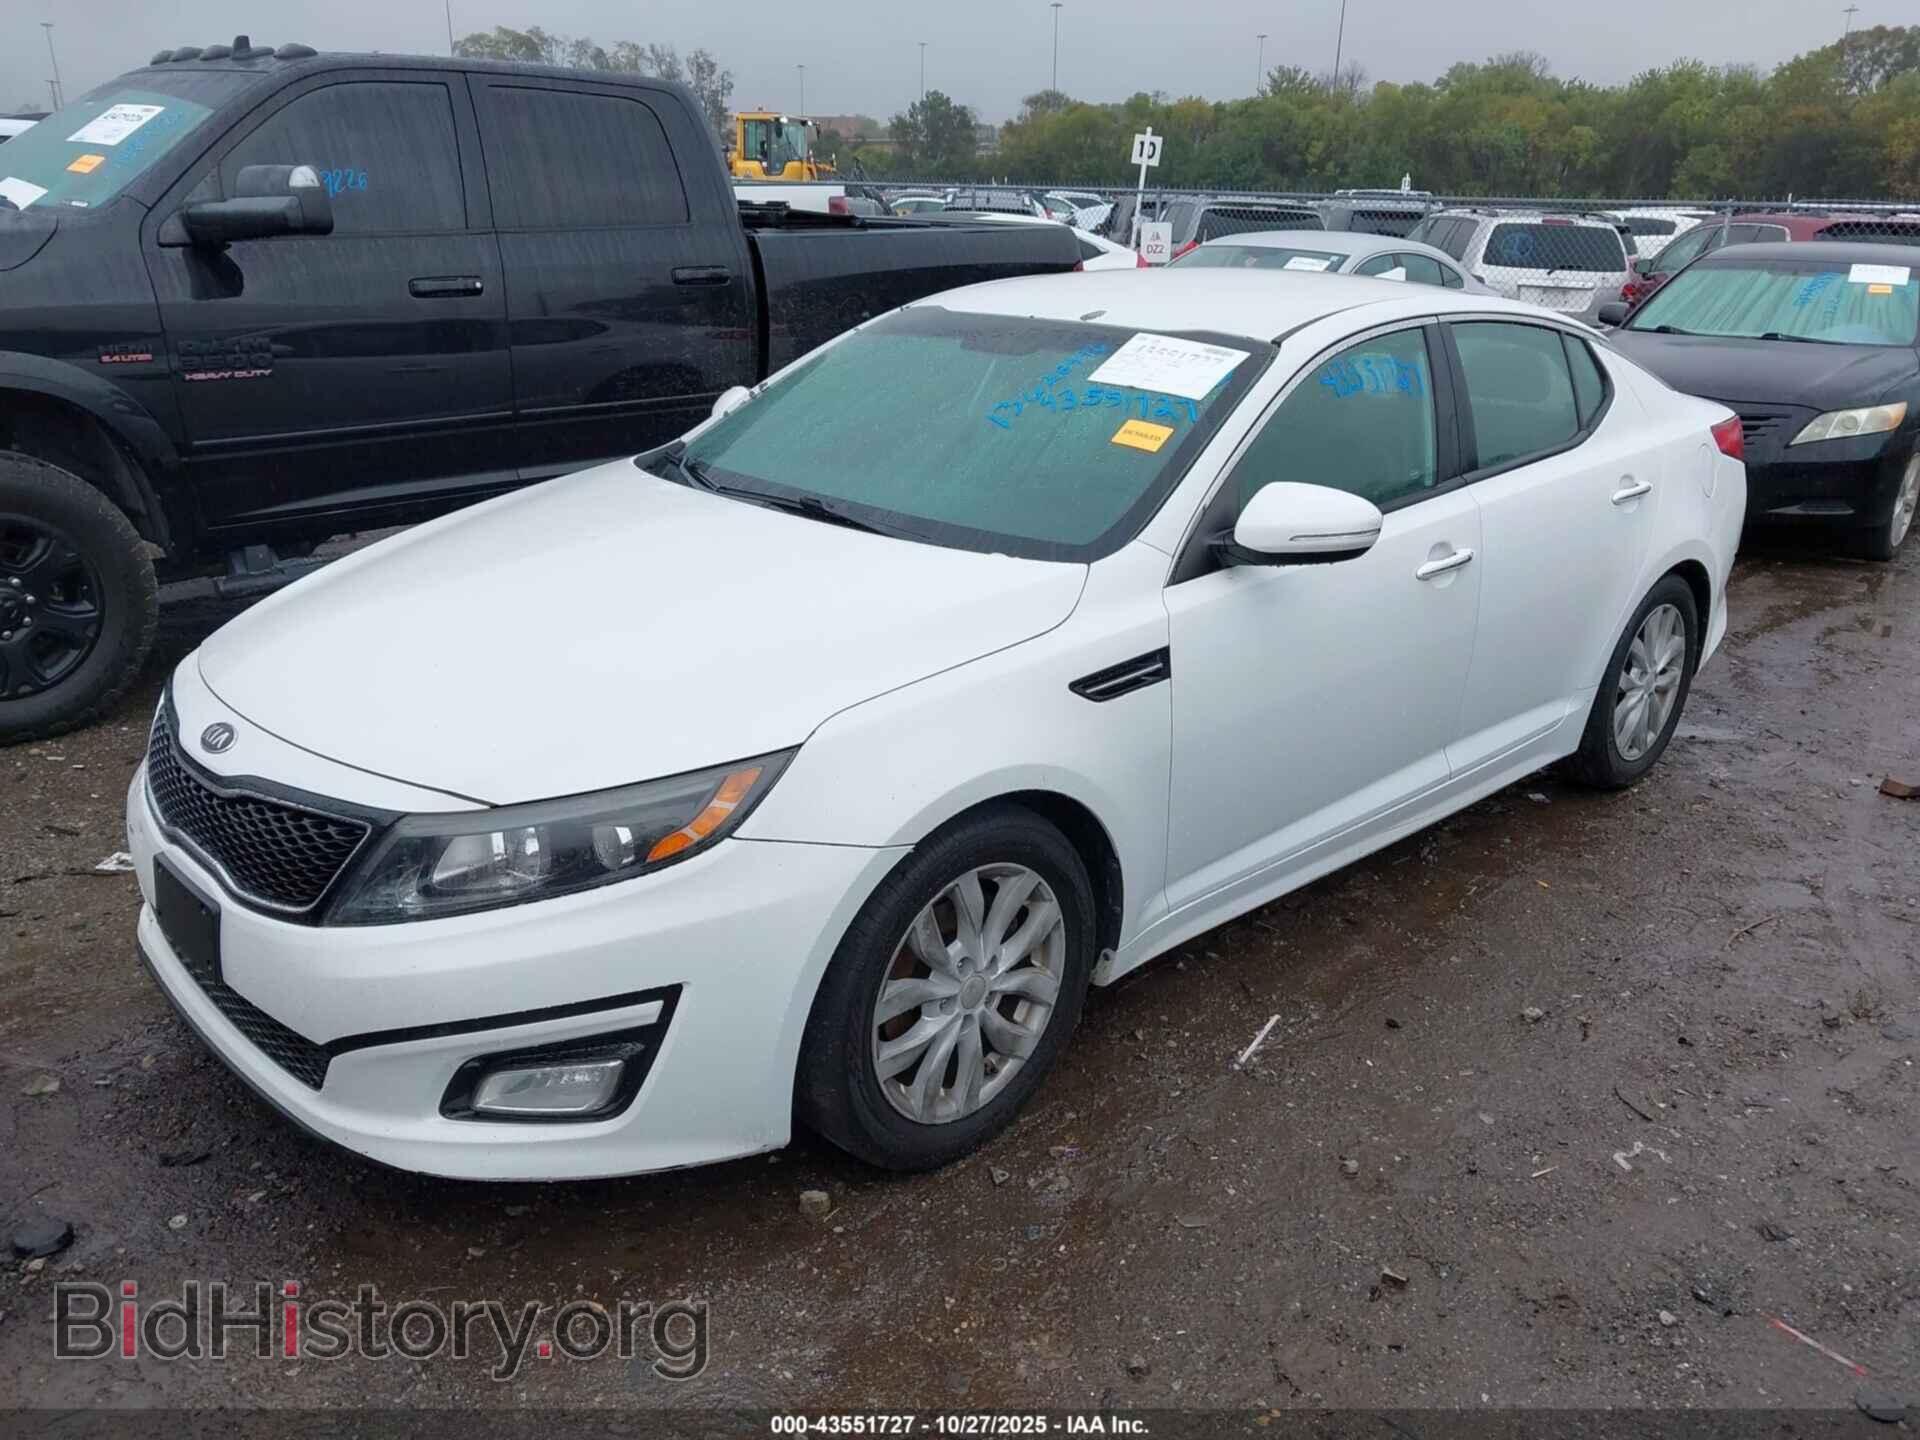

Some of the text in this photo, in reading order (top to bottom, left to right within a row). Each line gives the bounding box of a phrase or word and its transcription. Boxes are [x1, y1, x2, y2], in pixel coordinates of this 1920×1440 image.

[1146, 244, 1165, 255] DZ2
[184, 368, 273, 382] HEAVY DUTY
